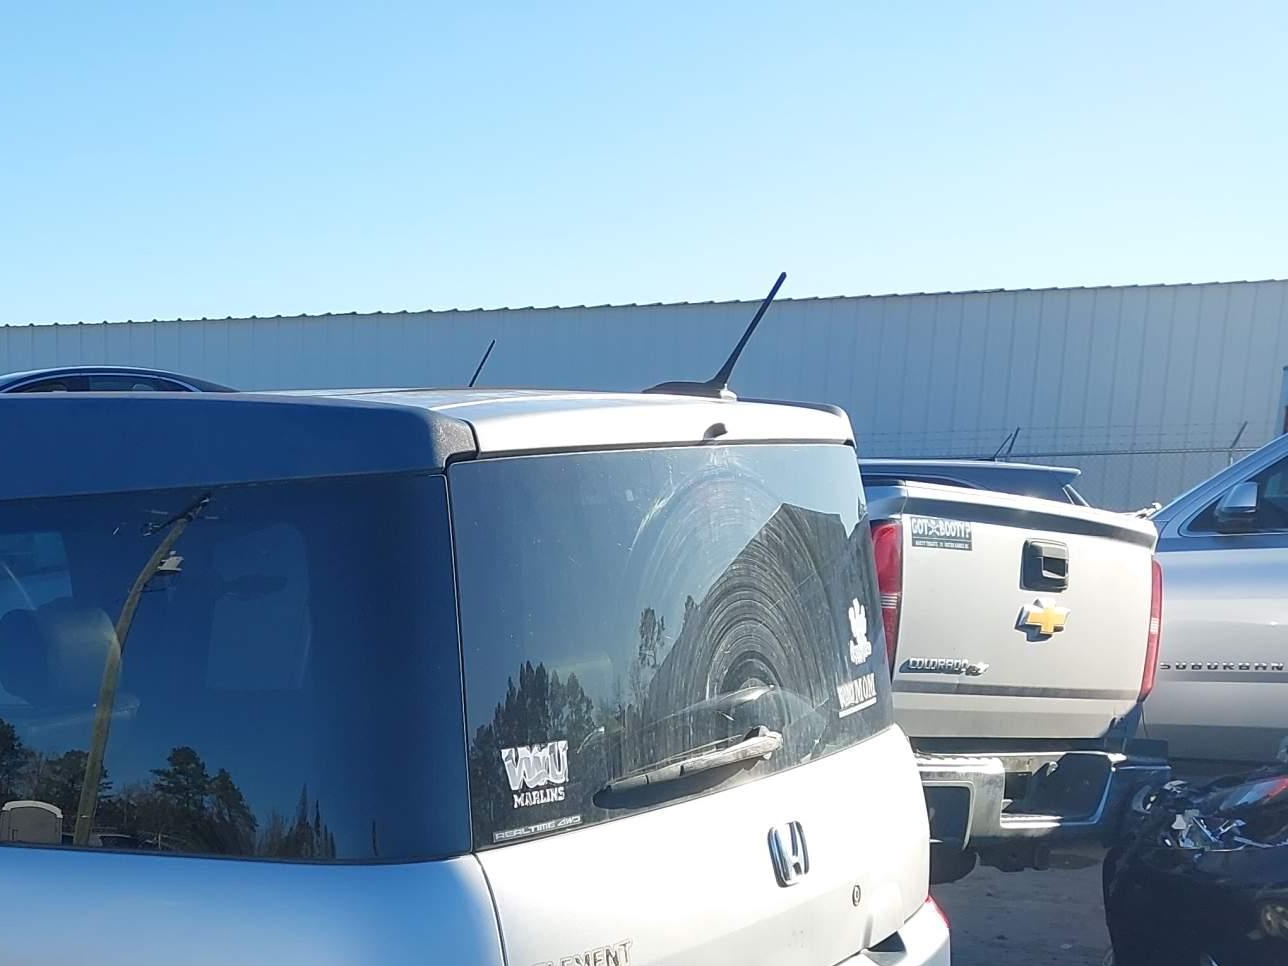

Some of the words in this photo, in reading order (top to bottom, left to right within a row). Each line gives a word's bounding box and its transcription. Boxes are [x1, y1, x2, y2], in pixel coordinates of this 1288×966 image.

[909, 657, 969, 672] COLORADO
[1159, 661, 1285, 671] SUBURBAN
[513, 786, 566, 809] MARLINS
[557, 815, 581, 828] 4WD
